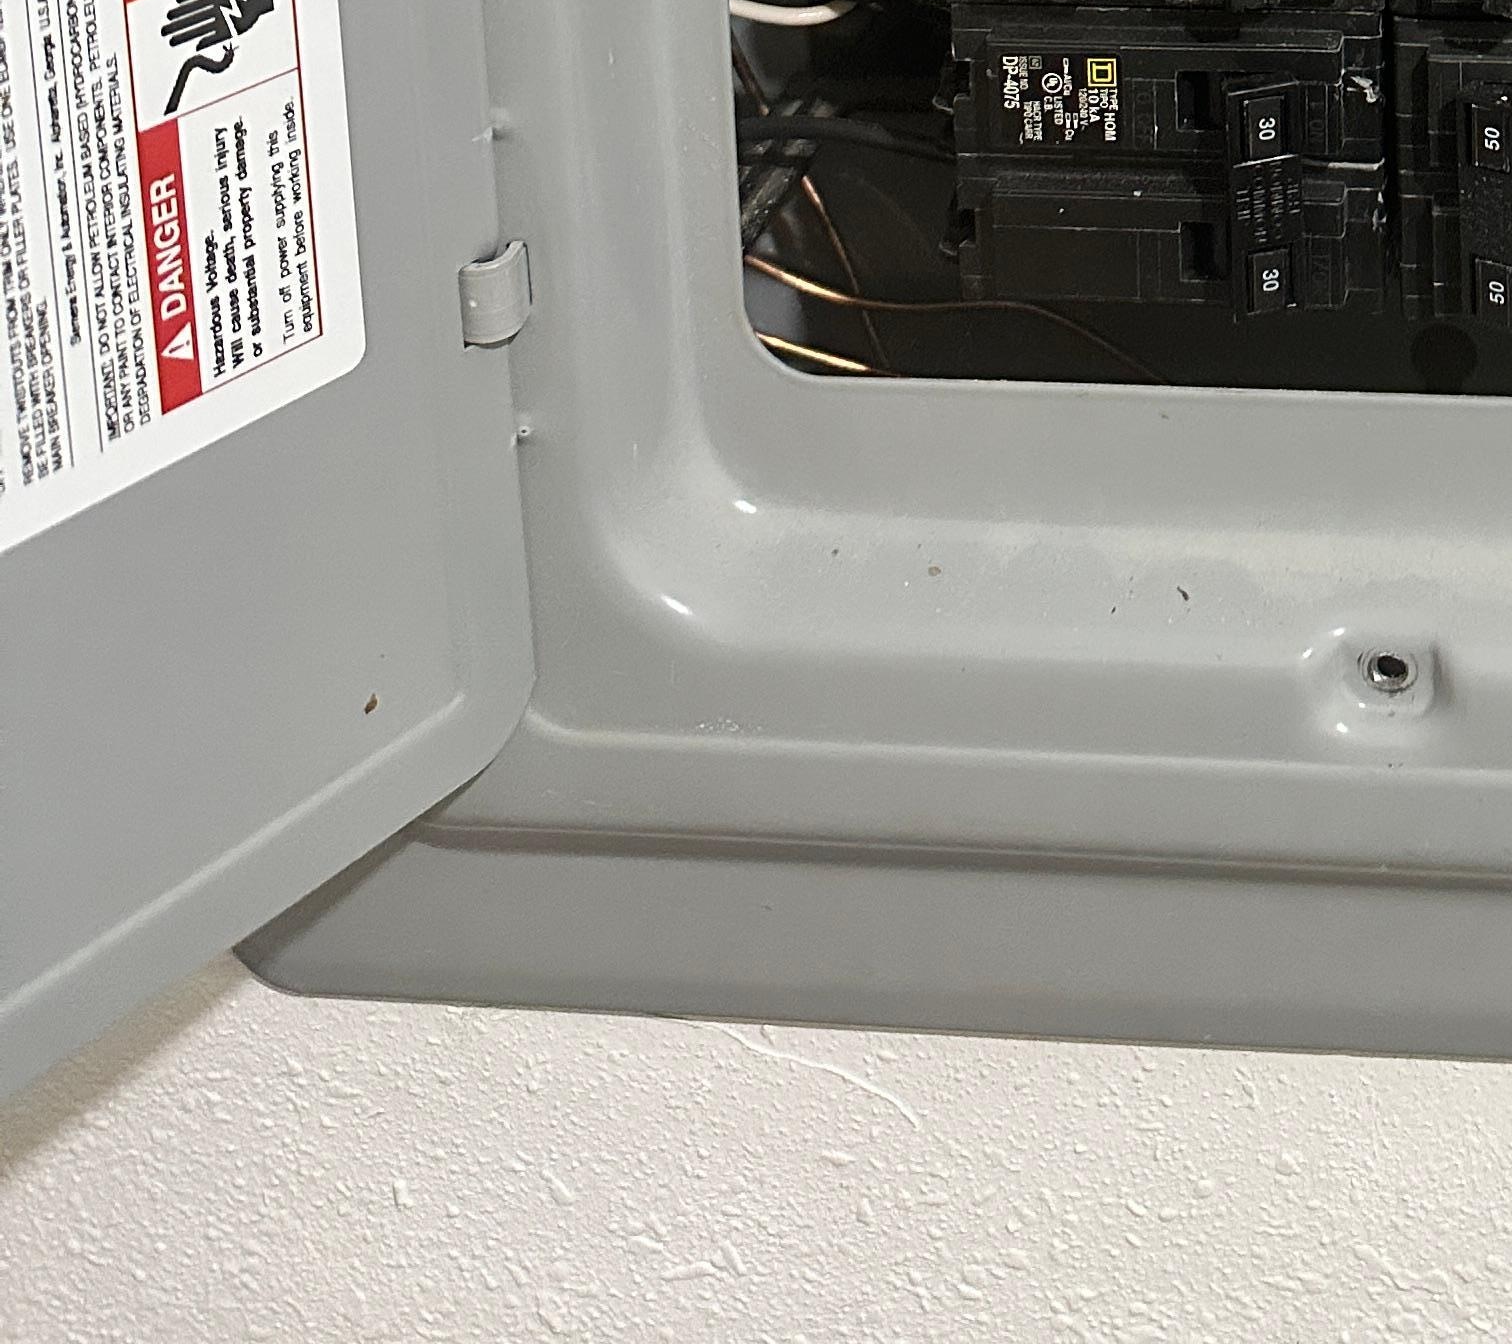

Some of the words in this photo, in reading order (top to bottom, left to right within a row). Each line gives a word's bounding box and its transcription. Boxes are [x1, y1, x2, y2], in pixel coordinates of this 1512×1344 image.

[105, 52, 123, 135] MATERIALS.
[1002, 56, 1020, 109] DP-4075
[1088, 88, 1100, 104] 10
[76, 111, 92, 160] BASED
[282, 96, 296, 142] inside.
[1088, 106, 1100, 123] kA
[1104, 112, 1116, 141] HOM
[1258, 117, 1276, 141] 30
[213, 126, 229, 172] injury
[233, 115, 247, 181] damage.
[266, 129, 280, 157] this
[1484, 127, 1501, 151] 50
[113, 136, 131, 218] INSULATING
[270, 160, 287, 228] supplying
[287, 147, 301, 204] working
[81, 162, 99, 249] PETROLEUM
[218, 174, 233, 232] serious
[237, 186, 256, 250] property
[149, 172, 187, 322] DANGER
[292, 209, 306, 256] before
[90, 250, 105, 298] ALLOW
[121, 217, 140, 305] ELECTRICAL
[204, 228, 218, 293] Voltage.
[222, 235, 237, 283] death,
[277, 235, 292, 278] power
[241, 253, 261, 336] substantial
[278, 284, 292, 303] off
[295, 259, 314, 332] equipment
[1262, 269, 1280, 292] 30
[1488, 281, 1506, 305] 50
[94, 301, 107, 331] NOT
[128, 307, 141, 326] OF
[228, 287, 241, 333] cause
[282, 308, 295, 344] Turn
[97, 332, 110, 356] DO
[209, 294, 226, 378] Hazardous
[230, 336, 244, 369] Will
[251, 341, 263, 357] or
[131, 326, 151, 426] DEGRADATION
